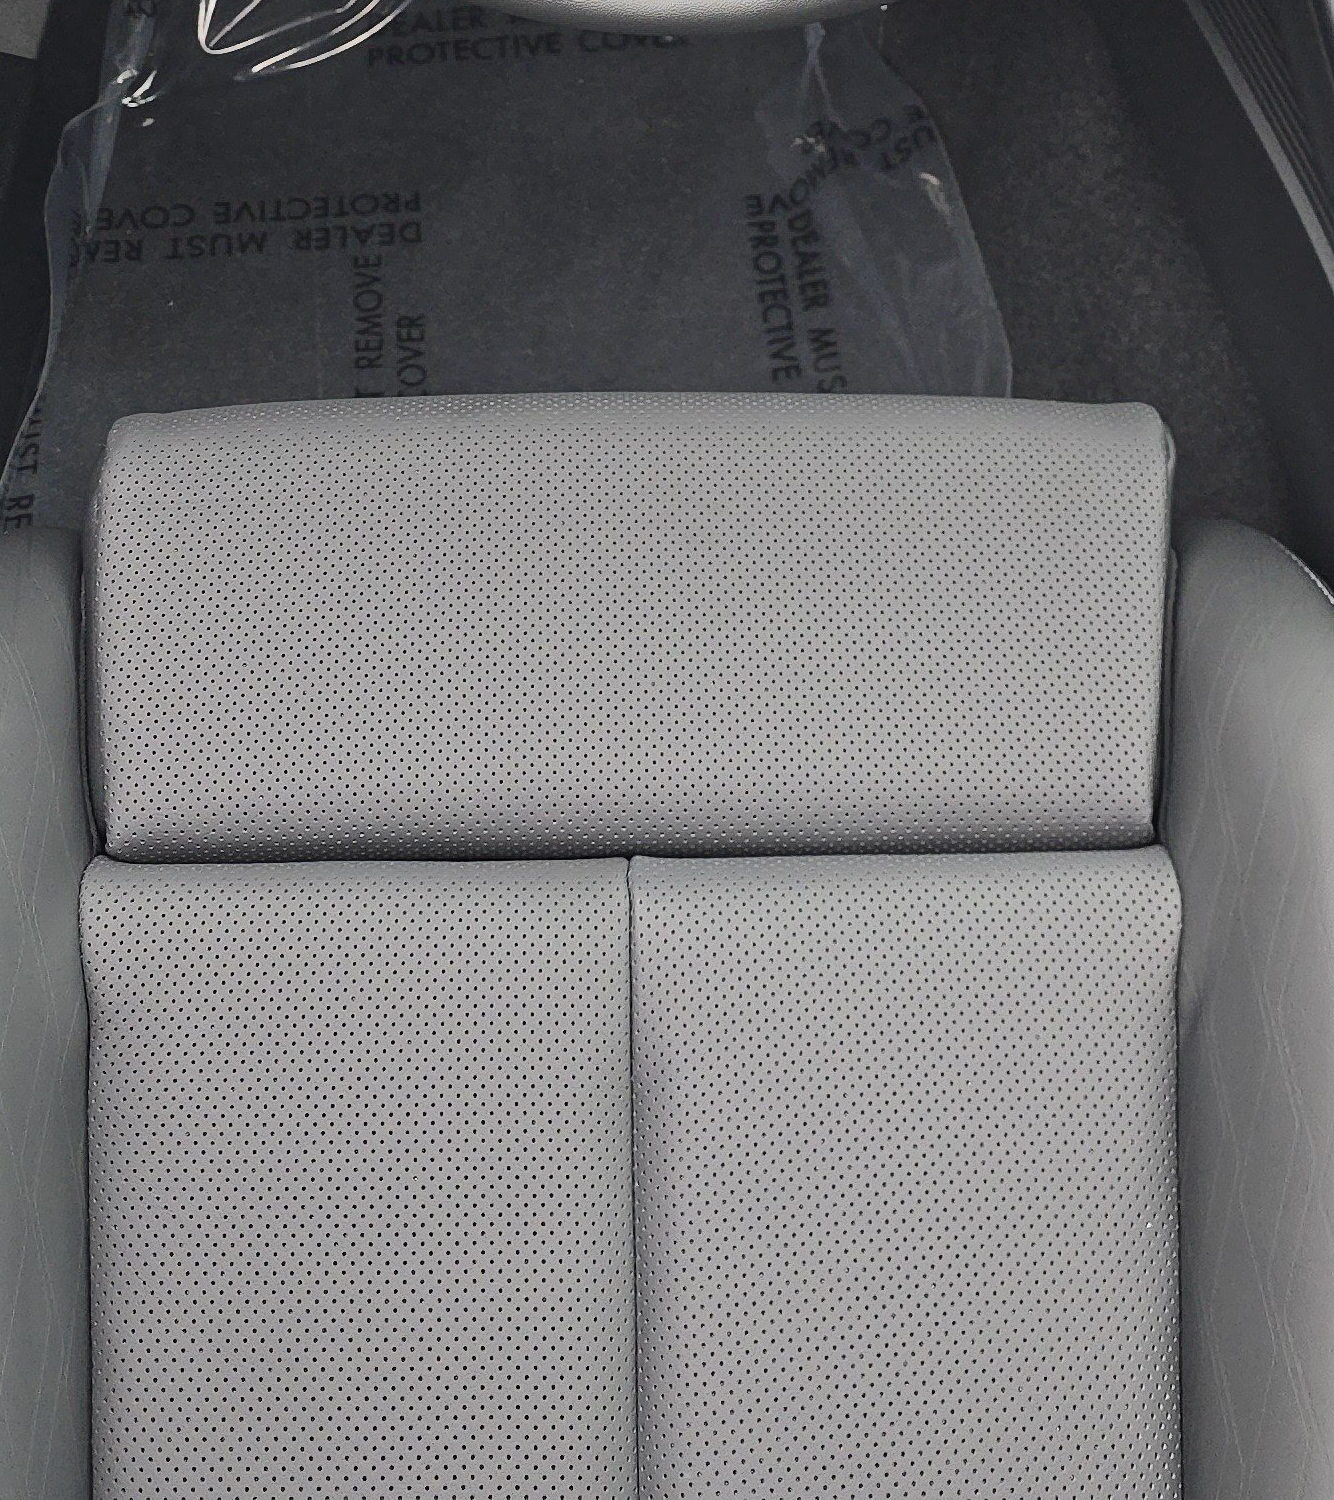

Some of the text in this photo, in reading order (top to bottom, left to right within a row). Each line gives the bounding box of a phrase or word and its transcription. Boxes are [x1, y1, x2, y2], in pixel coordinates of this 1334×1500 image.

[381, 5, 485, 38] EALER
[368, 31, 563, 67] PROTECTIVE
[212, 191, 422, 225] PROTECTIVE
[164, 231, 268, 262] MUST
[293, 221, 423, 251] DEALER
[352, 253, 384, 370] REMOVE
[747, 220, 803, 384] PROTECTIVE
[807, 327, 849, 393] MUS
